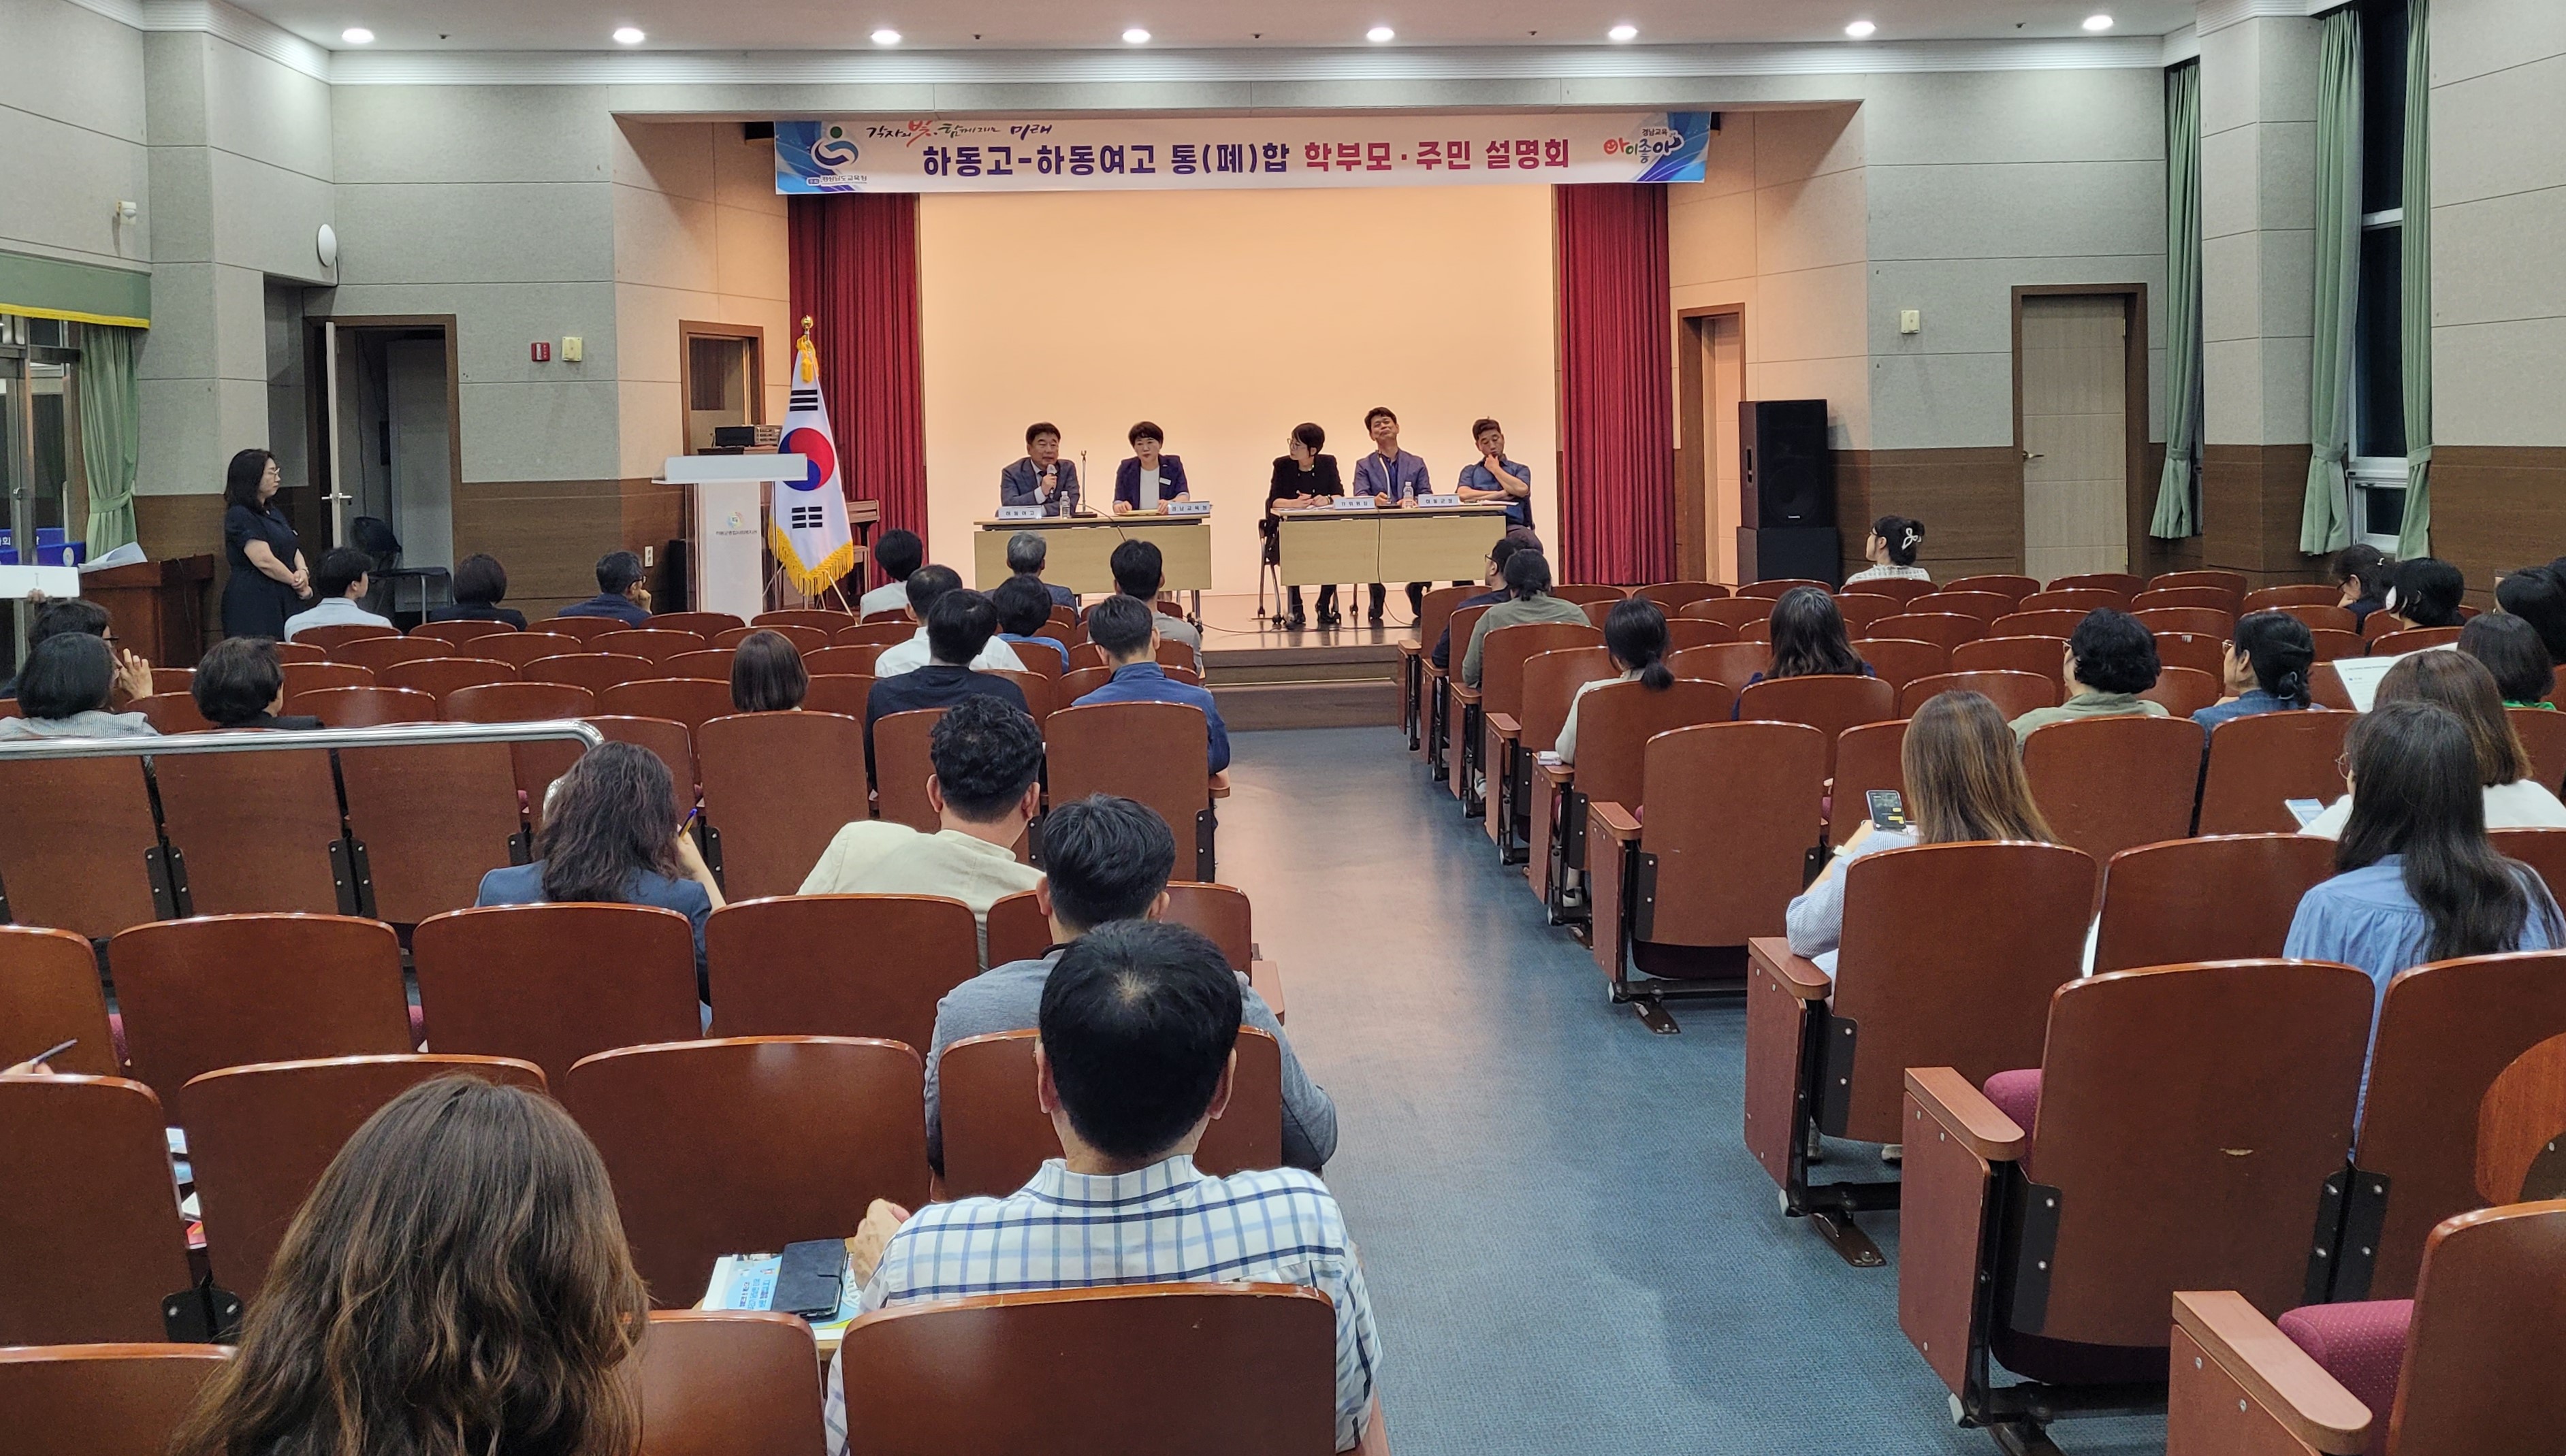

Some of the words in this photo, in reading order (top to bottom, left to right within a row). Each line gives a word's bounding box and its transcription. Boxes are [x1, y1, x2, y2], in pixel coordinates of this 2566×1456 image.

[866, 125, 911, 138] 각자의
[1010, 125, 1052, 140] 미래
[1641, 128, 1668, 136] 경남교육
[923, 144, 1156, 176] 하동고-하동여고
[1171, 142, 1290, 175] 통(폐)합
[1486, 138, 1569, 169] 설명회
[1603, 136, 1682, 163] 아이좋아
